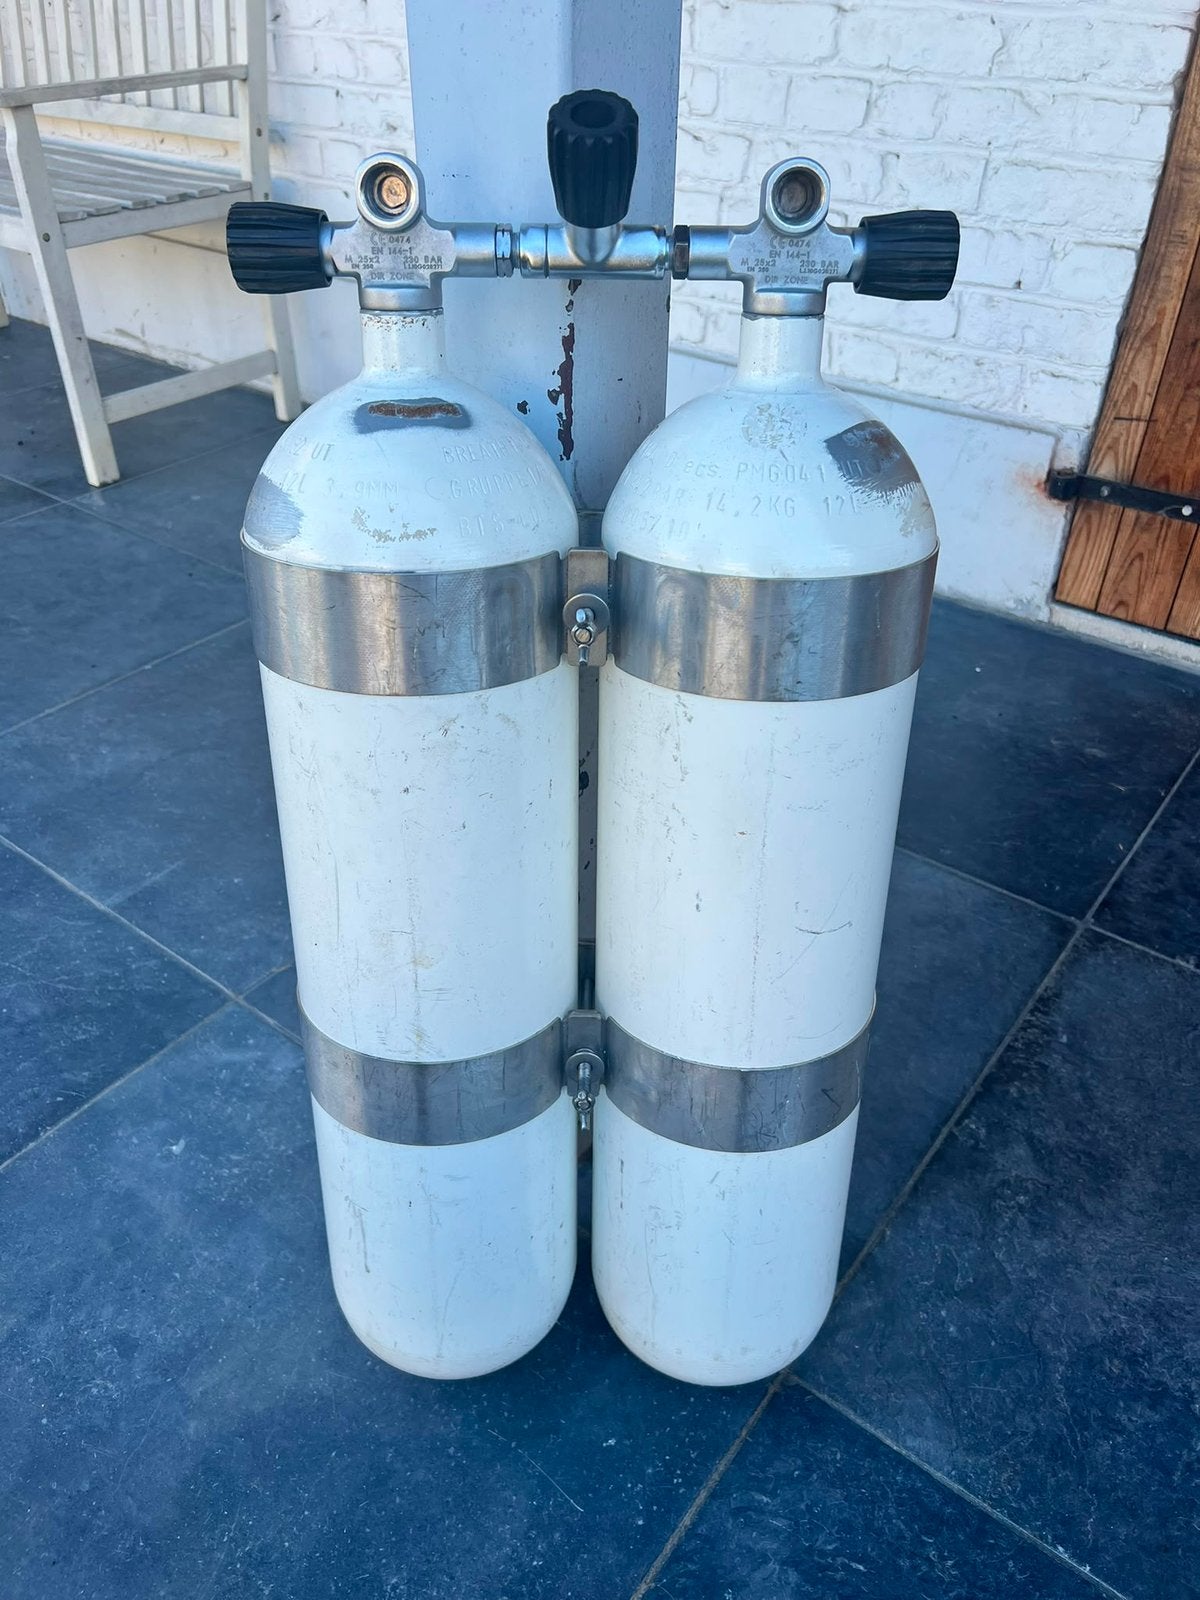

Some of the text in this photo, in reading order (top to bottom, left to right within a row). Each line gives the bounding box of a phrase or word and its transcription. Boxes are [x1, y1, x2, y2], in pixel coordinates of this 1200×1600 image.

[371, 247, 384, 255] EN
[769, 251, 781, 259] EN
[402, 256, 443, 264] 230 BAR
[740, 258, 749, 267] M
[799, 260, 840, 269] 230 BAR
[370, 272, 415, 281] DIR ZONE
[764, 275, 809, 285] DIR ZONE
